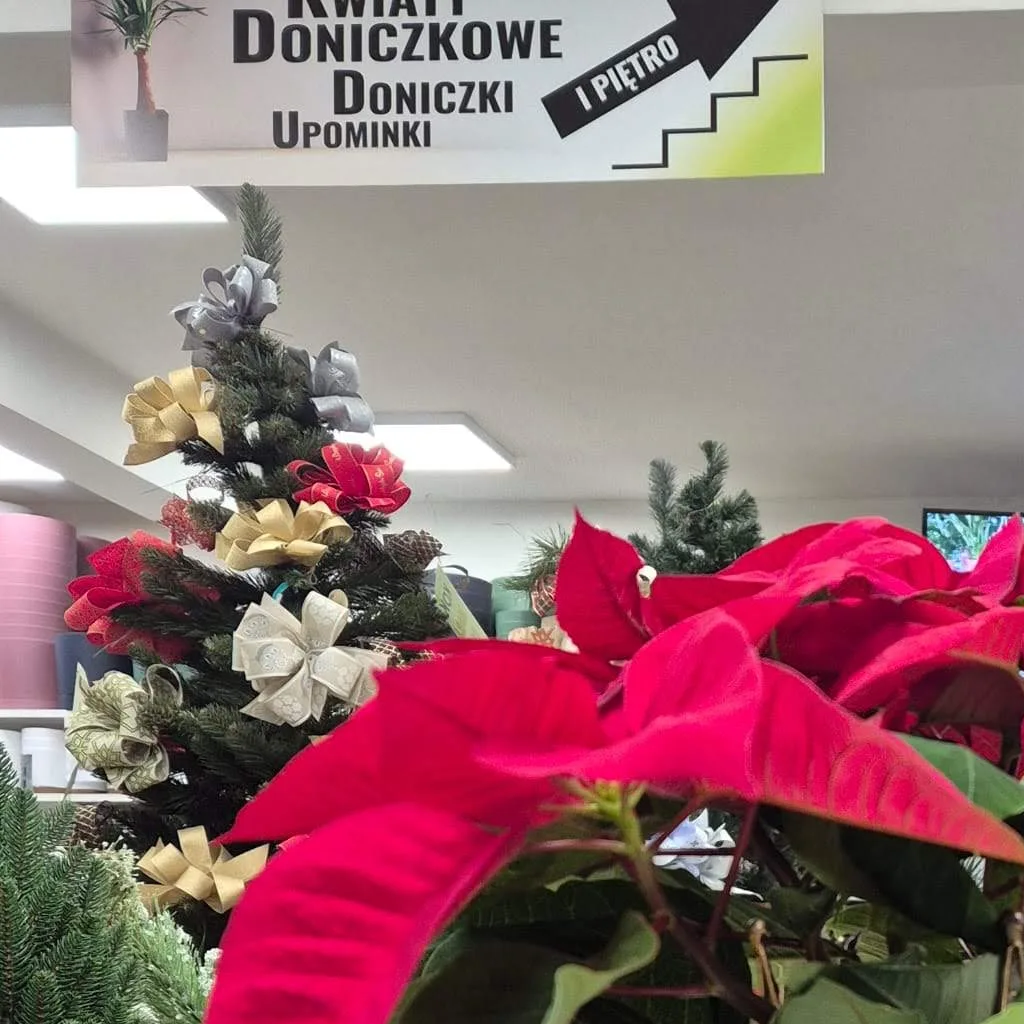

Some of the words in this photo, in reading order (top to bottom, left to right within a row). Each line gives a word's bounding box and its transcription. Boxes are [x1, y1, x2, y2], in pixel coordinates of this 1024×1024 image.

[233, 9, 563, 64] DONICZKOWE
[333, 69, 514, 115] DONICZKI
[575, 85, 592, 112] I
[590, 34, 680, 102] PIĘTRO
[272, 110, 431, 149] UPOMINKI
